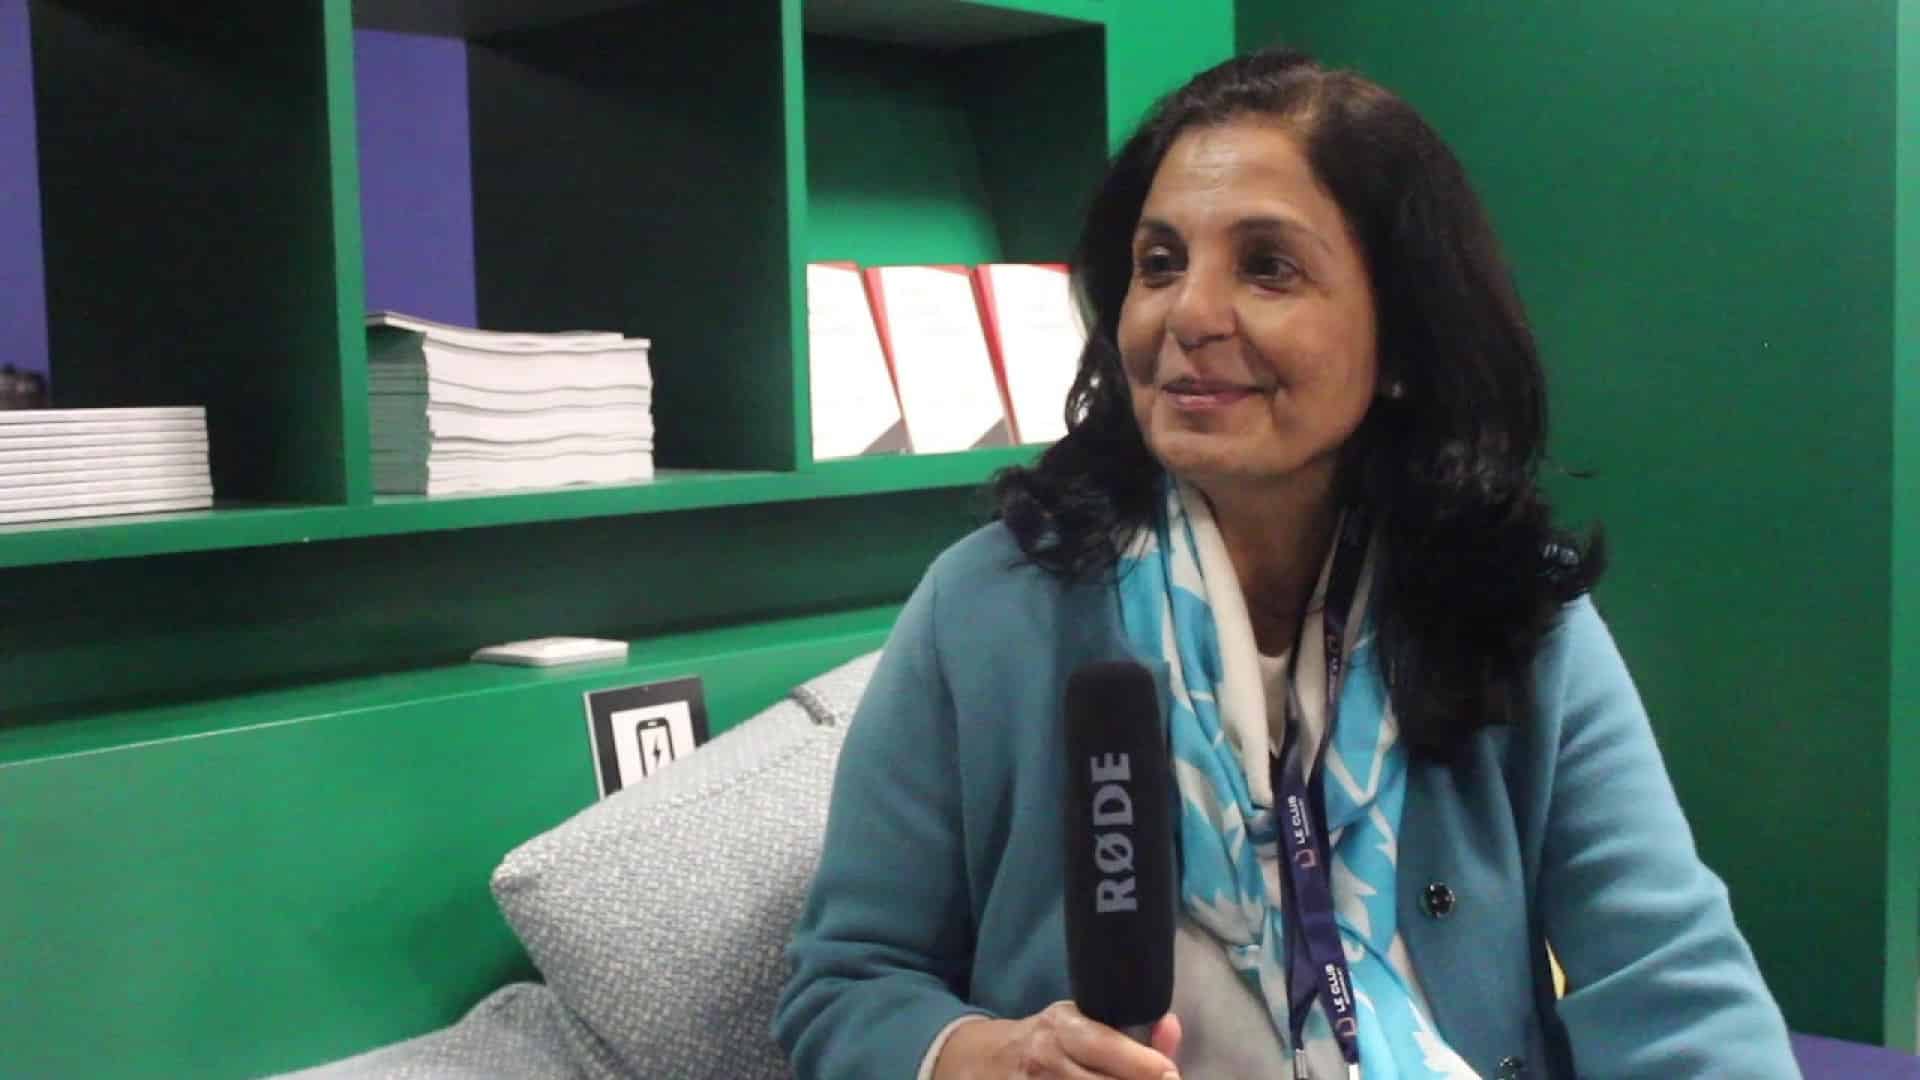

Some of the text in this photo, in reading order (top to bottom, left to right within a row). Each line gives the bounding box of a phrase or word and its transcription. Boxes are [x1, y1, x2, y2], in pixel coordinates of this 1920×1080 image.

[1287, 795, 1301, 826] CLUB
[1090, 752, 1138, 913] RØDE
[1294, 828, 1305, 845] LE
[1325, 963, 1341, 995] CLUB
[1333, 997, 1346, 1013] LE
